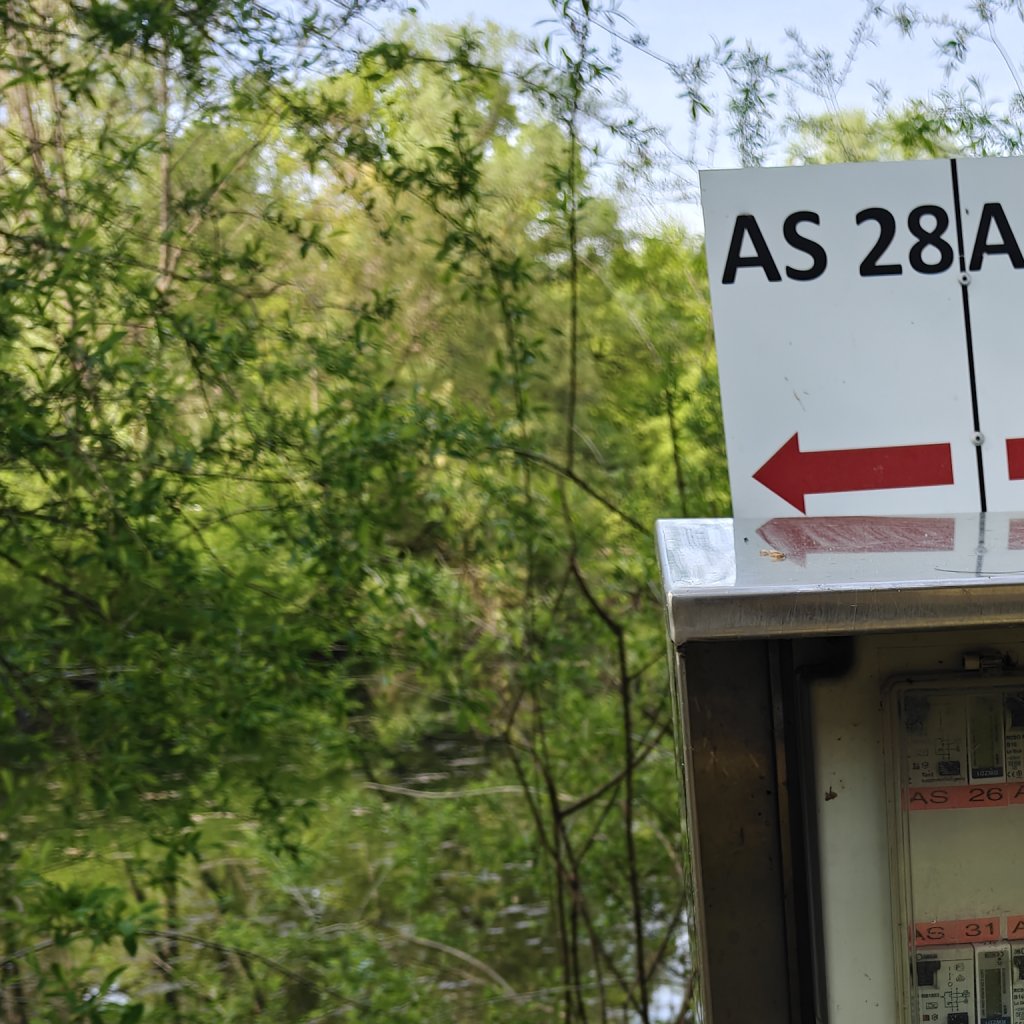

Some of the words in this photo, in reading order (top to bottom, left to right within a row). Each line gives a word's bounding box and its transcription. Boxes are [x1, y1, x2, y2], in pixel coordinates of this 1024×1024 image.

[721, 211, 828, 284] AS
[855, 205, 955, 277] 28
[910, 790, 949, 805] AS
[968, 787, 1003, 802] 26
[965, 922, 994, 937] 31
